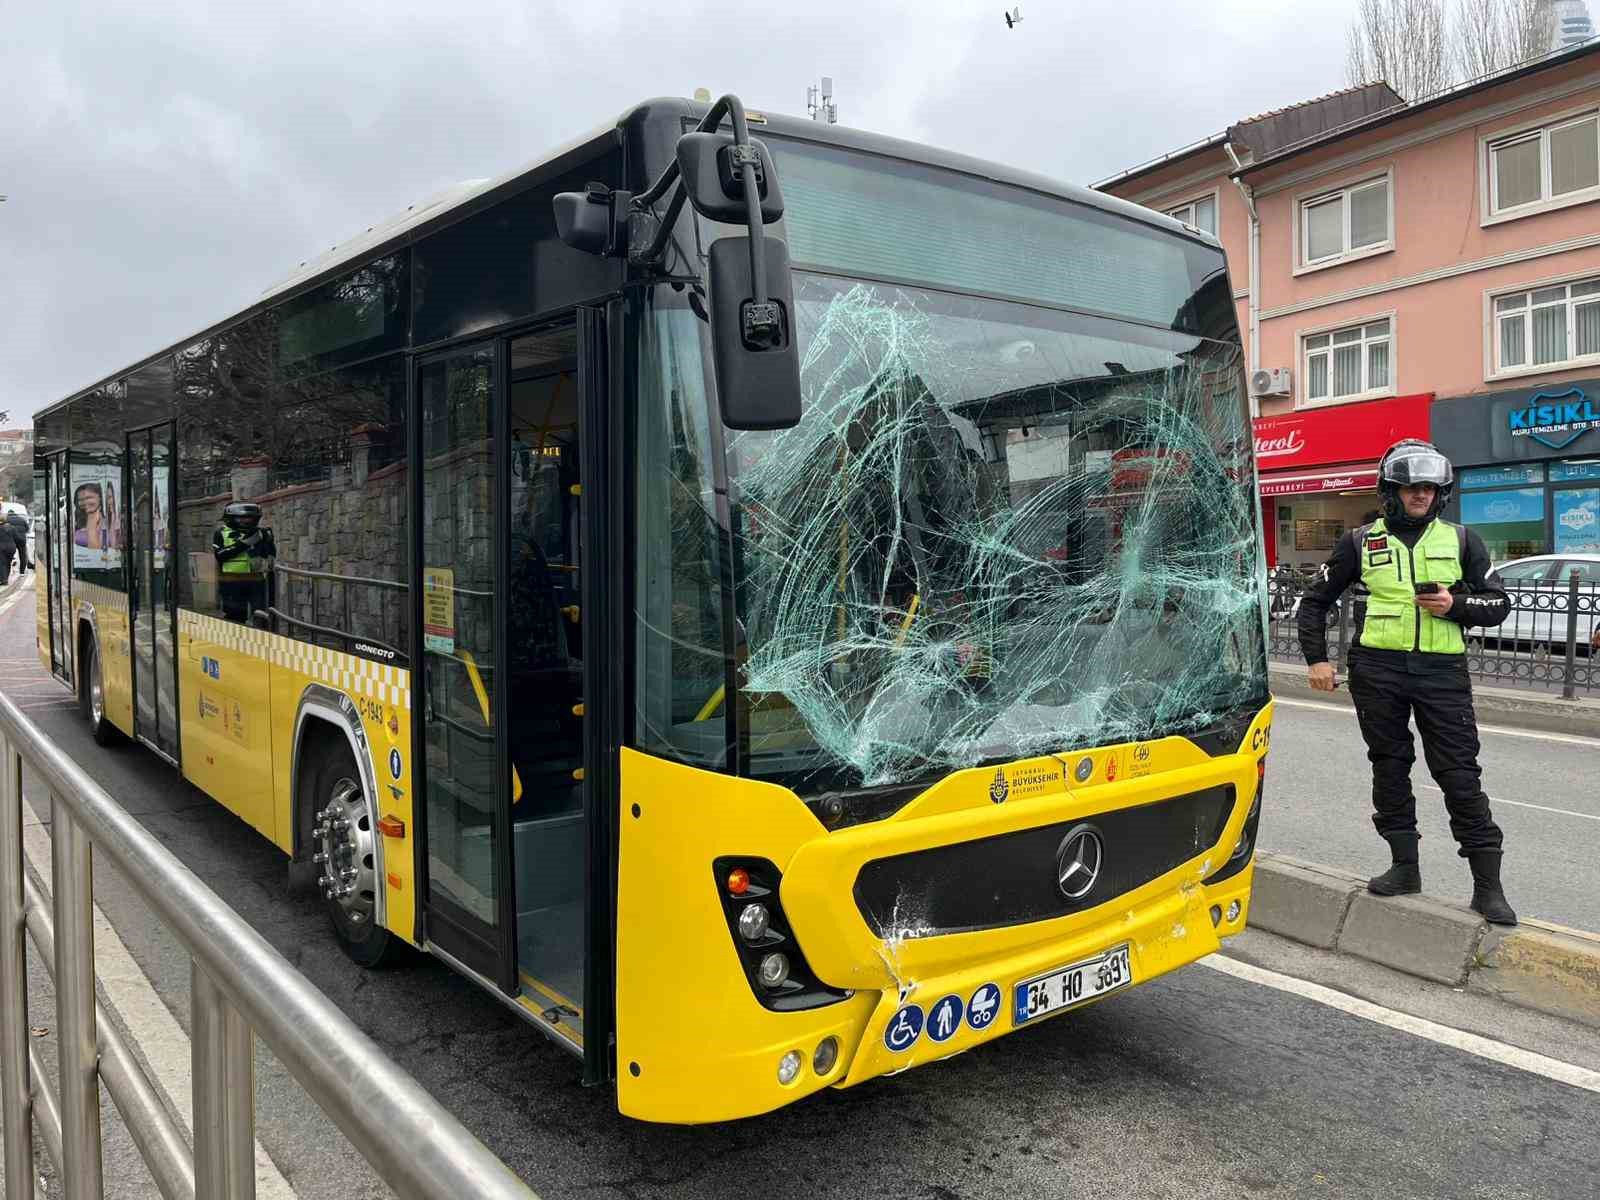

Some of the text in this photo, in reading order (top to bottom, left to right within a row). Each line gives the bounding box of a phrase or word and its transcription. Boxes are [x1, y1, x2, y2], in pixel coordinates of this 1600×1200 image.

[358, 696, 384, 725] C-1943
[1027, 980, 1050, 1014] 34
[1062, 970, 1083, 1003] HO
